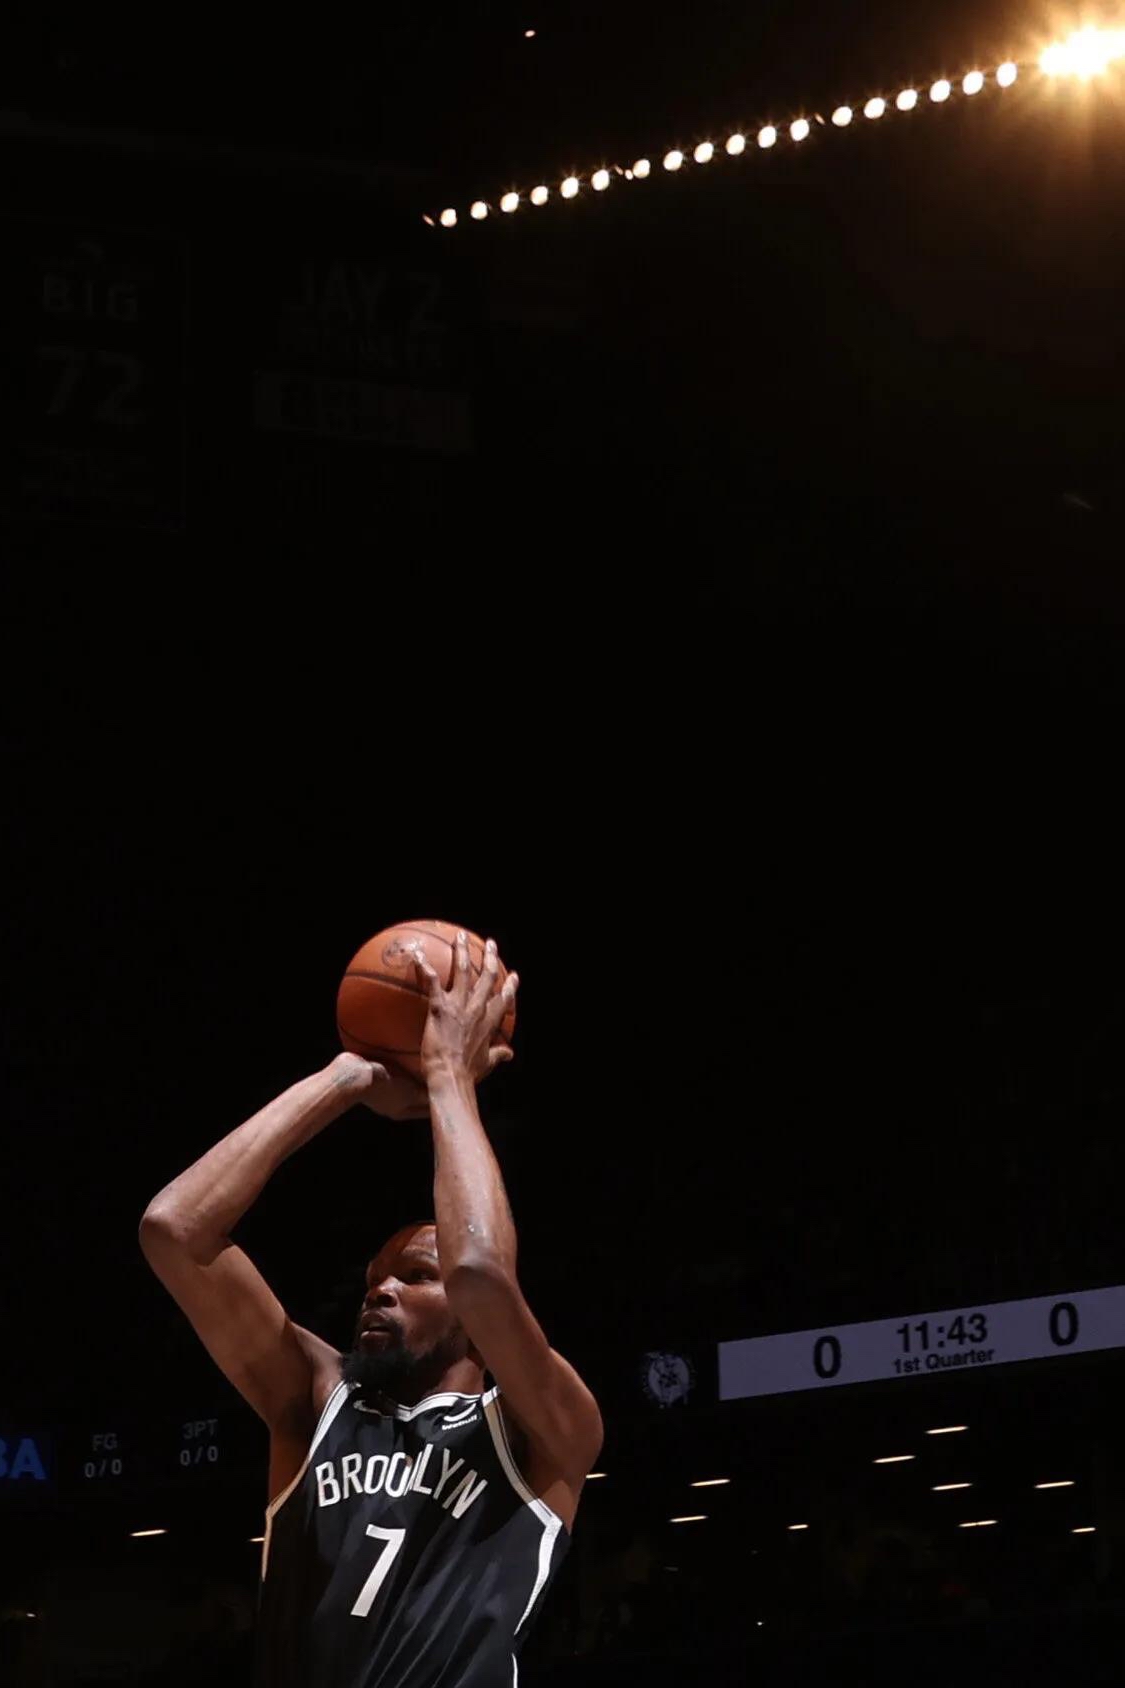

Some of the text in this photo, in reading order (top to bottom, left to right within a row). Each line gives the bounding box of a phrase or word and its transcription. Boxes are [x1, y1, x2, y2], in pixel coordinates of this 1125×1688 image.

[896, 1313, 988, 1352] 11:43
[1048, 1302, 1079, 1347] 0
[813, 1335, 842, 1379] 0
[893, 1349, 994, 1374] 1st Quarter
[92, 1432, 118, 1451] FG
[182, 1418, 218, 1440] 3PT
[350, 1523, 407, 1618] 7
